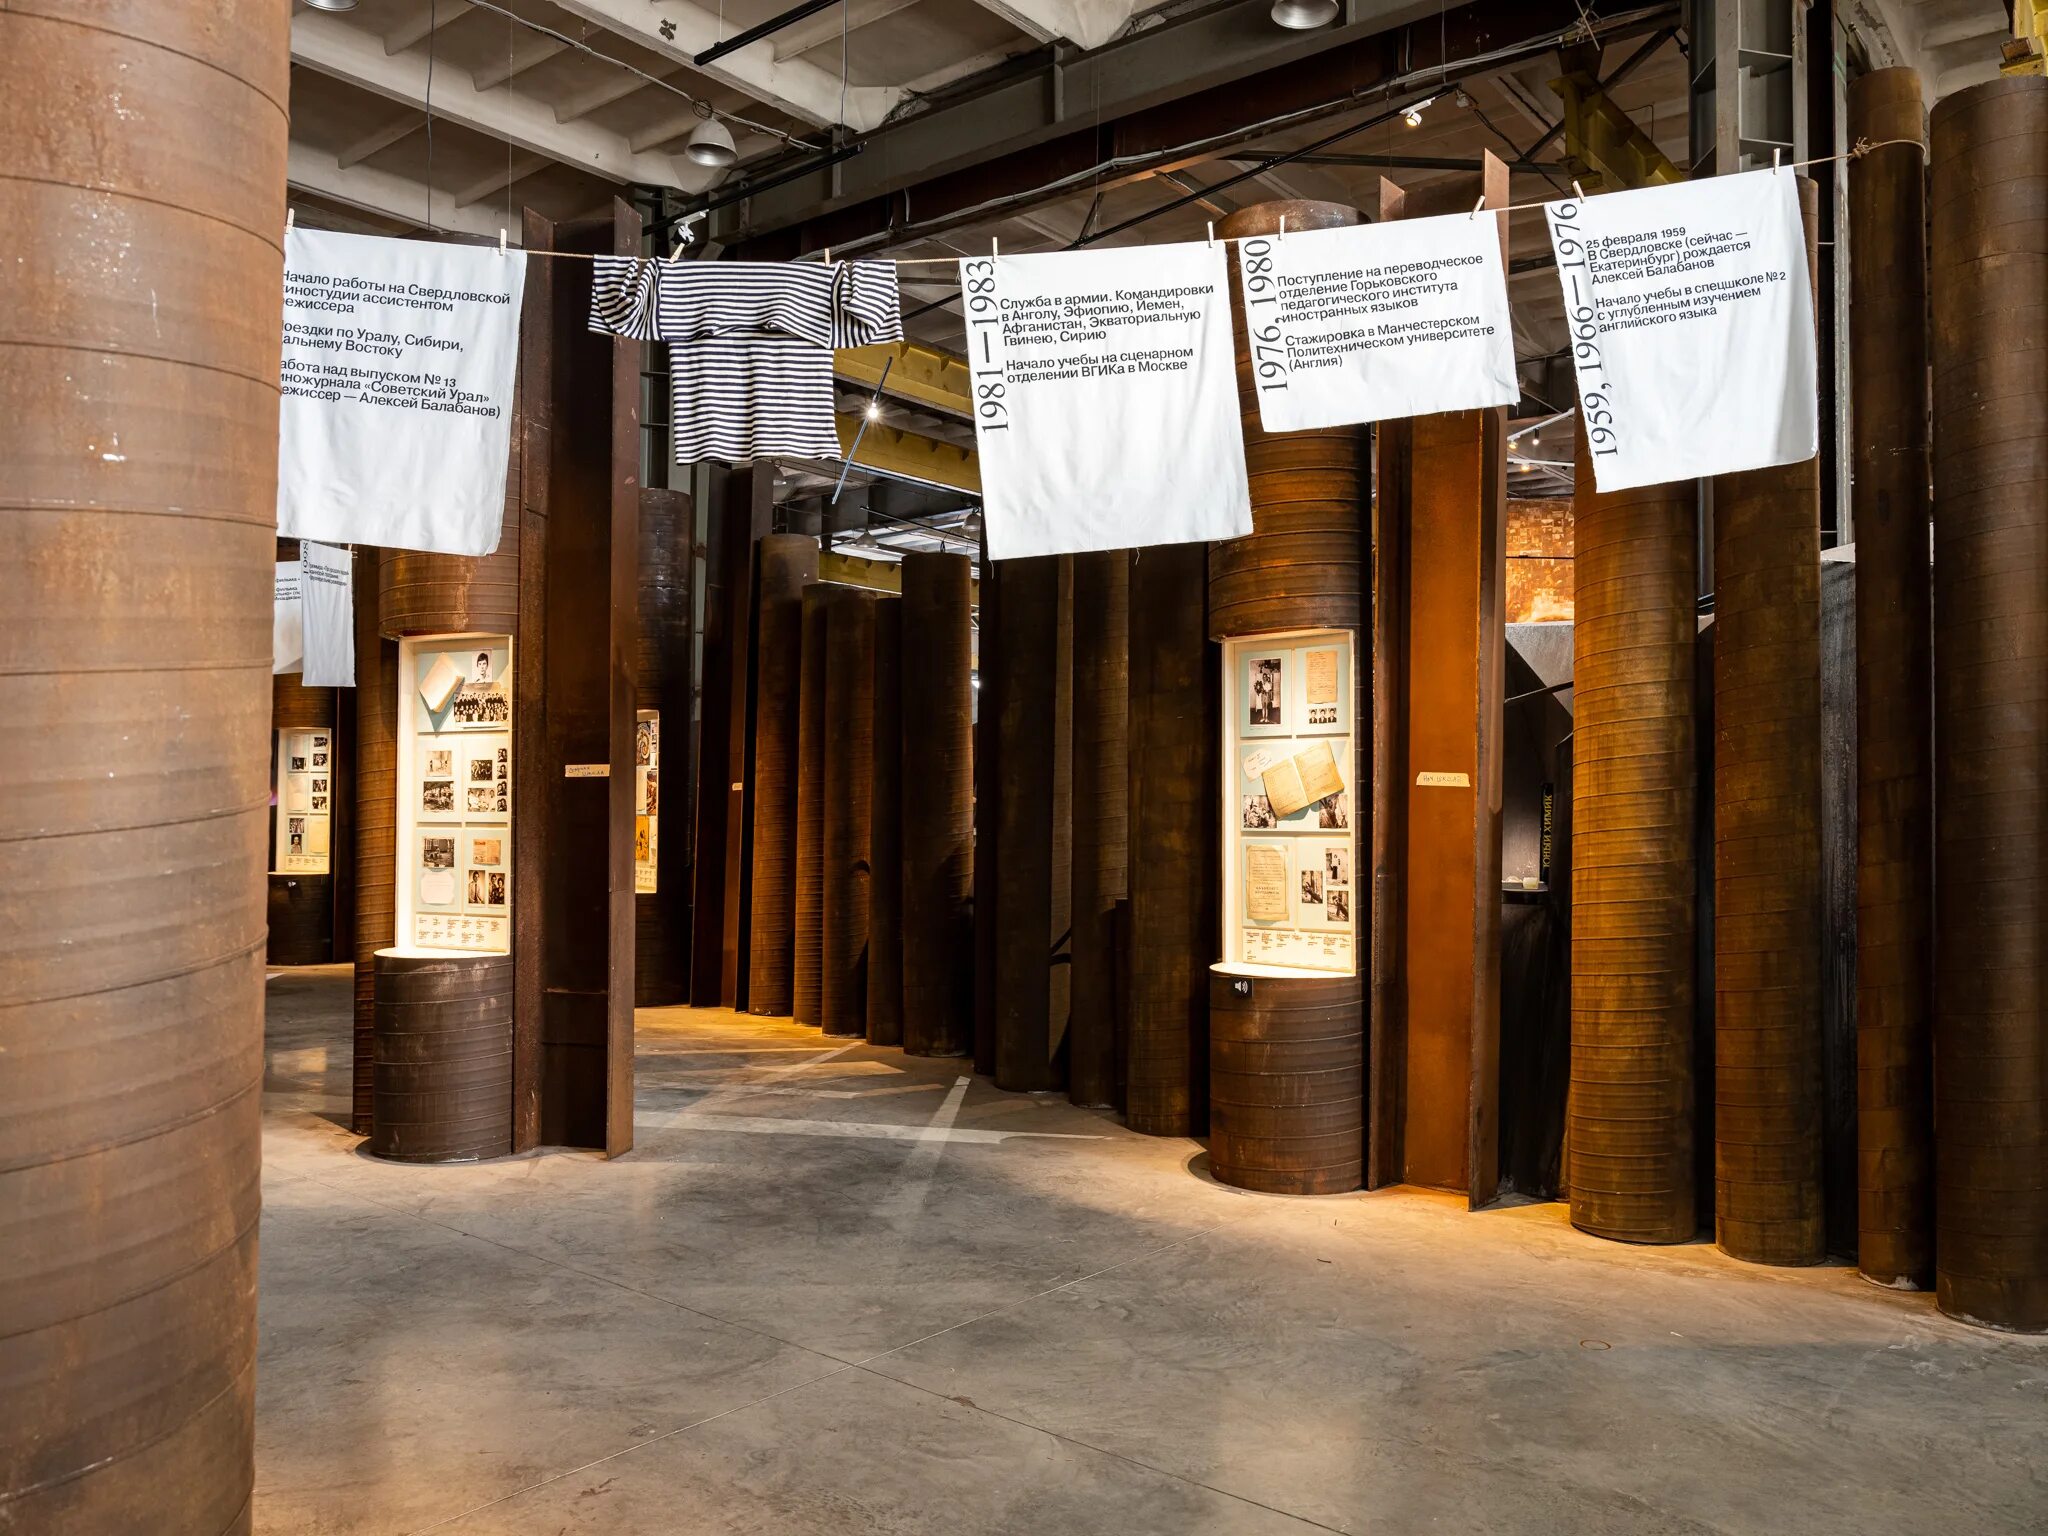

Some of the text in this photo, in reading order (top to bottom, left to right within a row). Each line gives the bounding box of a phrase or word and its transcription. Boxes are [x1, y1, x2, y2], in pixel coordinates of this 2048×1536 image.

[1586, 226, 1686, 250] 25 февраля 1959
[1587, 250, 1597, 261] В
[1599, 240, 1683, 260] Свердловске
[1685, 232, 1733, 249] (сейчас
[1589, 241, 1751, 273] Екатеринбург) рождается
[1243, 239, 1277, 308] 1980
[1277, 255, 1483, 287] Поступление на переводческое
[1592, 259, 1715, 285] Алексей Балабанов
[283, 285, 454, 312] иностудии ассистентом
[332, 277, 386, 292] работы
[388, 284, 405, 294] на
[408, 284, 510, 304] Свердловской
[1000, 285, 1214, 311] Служба в армии. Командировки
[1279, 272, 1438, 300] отделение Горьковского
[1280, 282, 1458, 311] педагогического института
[1595, 294, 1641, 309] Начало
[1643, 286, 1682, 304] учебы
[1684, 286, 1692, 295] в
[1694, 274, 1764, 294] спецшколе
[1779, 272, 1786, 280] 2
[283, 298, 354, 314] ежиссера
[1002, 298, 1184, 322] в Анголу, Эфиопию, Йемен,
[1282, 298, 1418, 323] иностранных языков
[1597, 287, 1761, 322] с углубленным изучением
[1002, 310, 1201, 336] Афганистан, Экваториальную
[1285, 316, 1480, 346] Стажировка в Манчестерском
[1599, 306, 1718, 333] английского языка
[282, 335, 403, 359] альнему Востоку
[336, 328, 354, 339] по
[357, 328, 400, 346] Уралу,
[404, 334, 463, 352] Сибири,
[1004, 330, 1107, 346] Гвинею, Сирию
[1287, 326, 1495, 358] Политехническом университете
[281, 358, 320, 374] абота
[323, 365, 348, 378] над
[350, 368, 421, 384] выпуском
[444, 378, 456, 388] 13
[1006, 348, 1194, 371] Начало учебы на сценарном
[1007, 360, 1188, 384] отделении ВГИКа в Москве
[1289, 354, 1343, 372] (Англия)
[364, 381, 446, 399] «Советский
[449, 388, 490, 403] Урал»
[359, 392, 418, 408] Алексей
[421, 398, 500, 420] Балабанов)
[1584, 382, 1618, 457] 1959,
[1542, 794, 1553, 868] ЮНЫЙ ХИМИК
